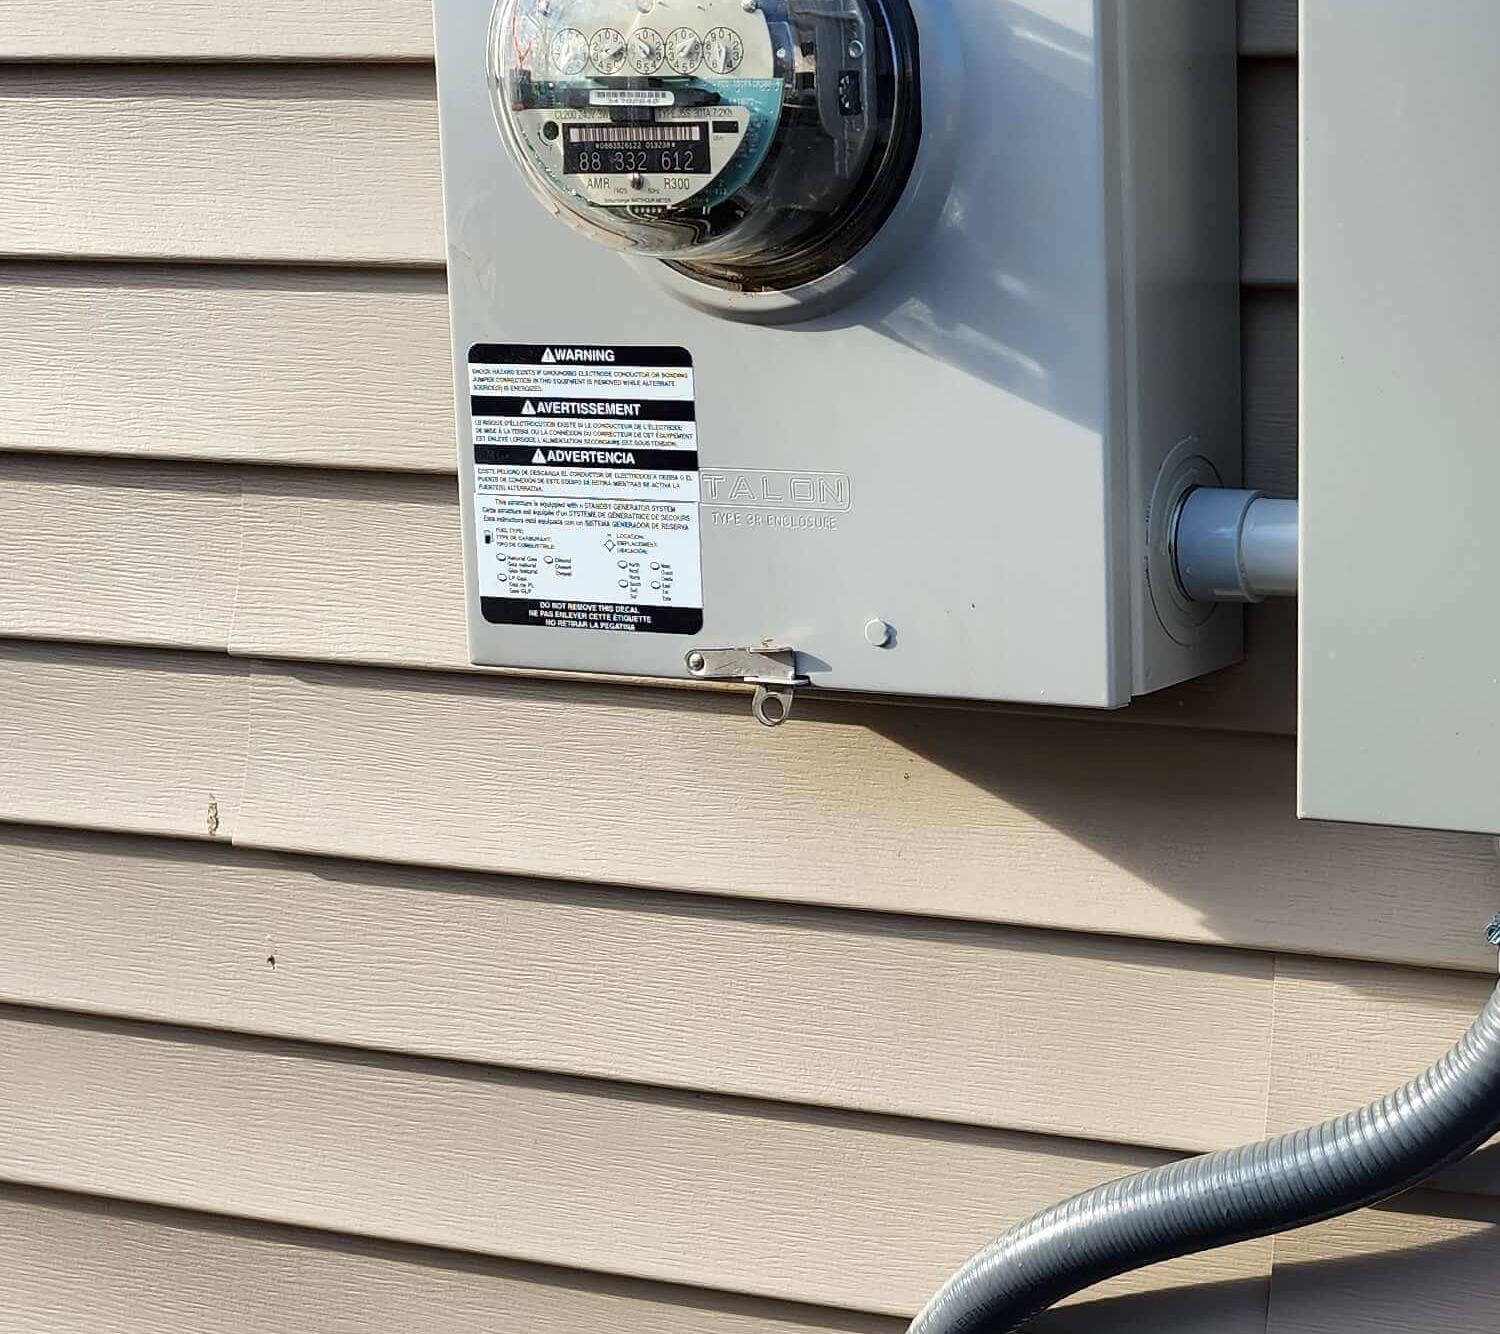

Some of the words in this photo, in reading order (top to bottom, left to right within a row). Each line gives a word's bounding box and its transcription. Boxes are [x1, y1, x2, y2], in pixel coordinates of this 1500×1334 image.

[579, 152, 601, 171] 88
[614, 151, 648, 171] 332
[661, 151, 695, 171] 612
[587, 178, 610, 190] AMR
[664, 177, 690, 190] R300
[555, 348, 615, 362] WARNING
[536, 401, 641, 416] AVERTISSEMENT
[547, 450, 636, 464] ADVERTENCIA
[701, 473, 844, 505] TALON
[712, 511, 742, 526] TYPE
[766, 514, 838, 531] ENCLOSURE
[540, 601, 550, 609] DO
[552, 602, 566, 610] NOT
[567, 603, 598, 612] REMOVE
[598, 605, 614, 613] THIS
[540, 610, 554, 618] PAS
[554, 610, 587, 620] ENLEVER
[588, 612, 612, 621] CETTE
